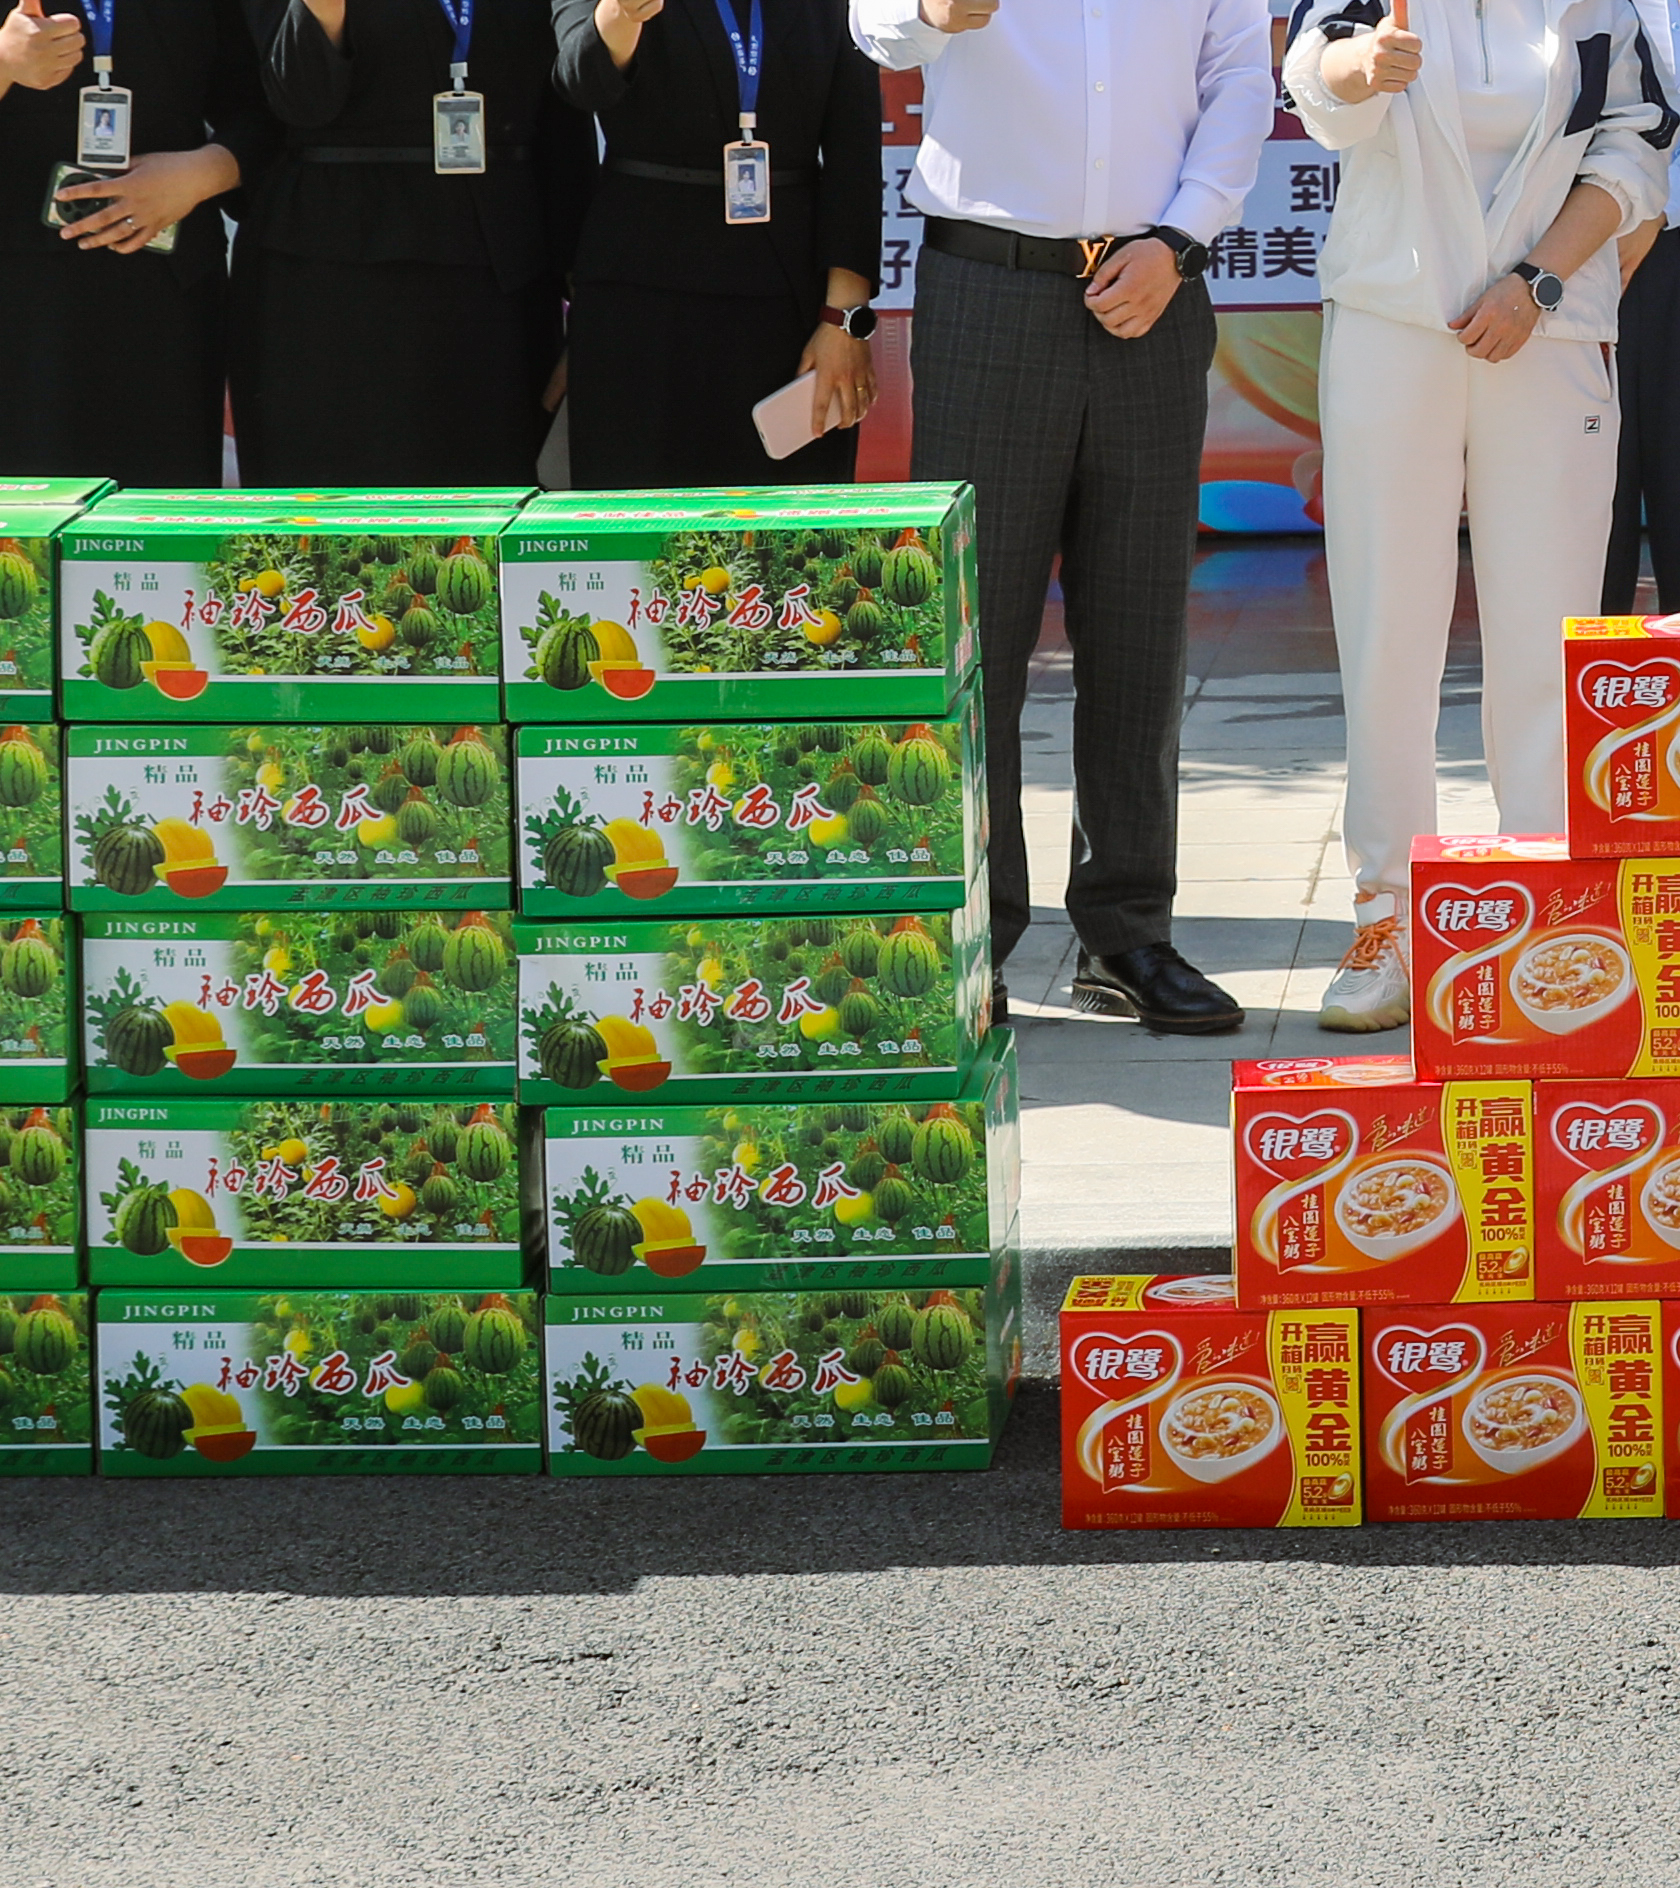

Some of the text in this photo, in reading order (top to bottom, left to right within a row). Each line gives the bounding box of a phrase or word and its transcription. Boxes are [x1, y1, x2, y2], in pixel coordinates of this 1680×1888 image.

[517, 538, 590, 554] JINGPIN
[181, 589, 378, 633] 袖珍西瓜
[627, 585, 825, 628] 袖珍西瓜
[1591, 674, 1670, 711] 银鹭
[93, 736, 189, 753] JINGPIN
[543, 736, 640, 753] JINGPIN
[594, 763, 649, 784] 精品
[1615, 764, 1632, 807] 八宝粥
[1633, 742, 1653, 806] 桂圆莲子
[638, 783, 835, 827] 袖珍西瓜
[764, 846, 931, 865] 天然 生态 佳品
[197, 971, 391, 1014] 袖珍西瓜
[629, 978, 825, 1024] 袖珍西瓜
[1258, 1125, 1338, 1158] 银鹭
[1478, 1094, 1528, 1225] 赢黄金
[1085, 1345, 1165, 1380] 银鹭
[1281, 1322, 1303, 1364] 开箱
[216, 1350, 411, 1394] 袖珍西瓜
[666, 1350, 860, 1392] 袖珍西瓜
[1304, 1321, 1354, 1453] 赢黄金
[1305, 1453, 1343, 1466] 100%
